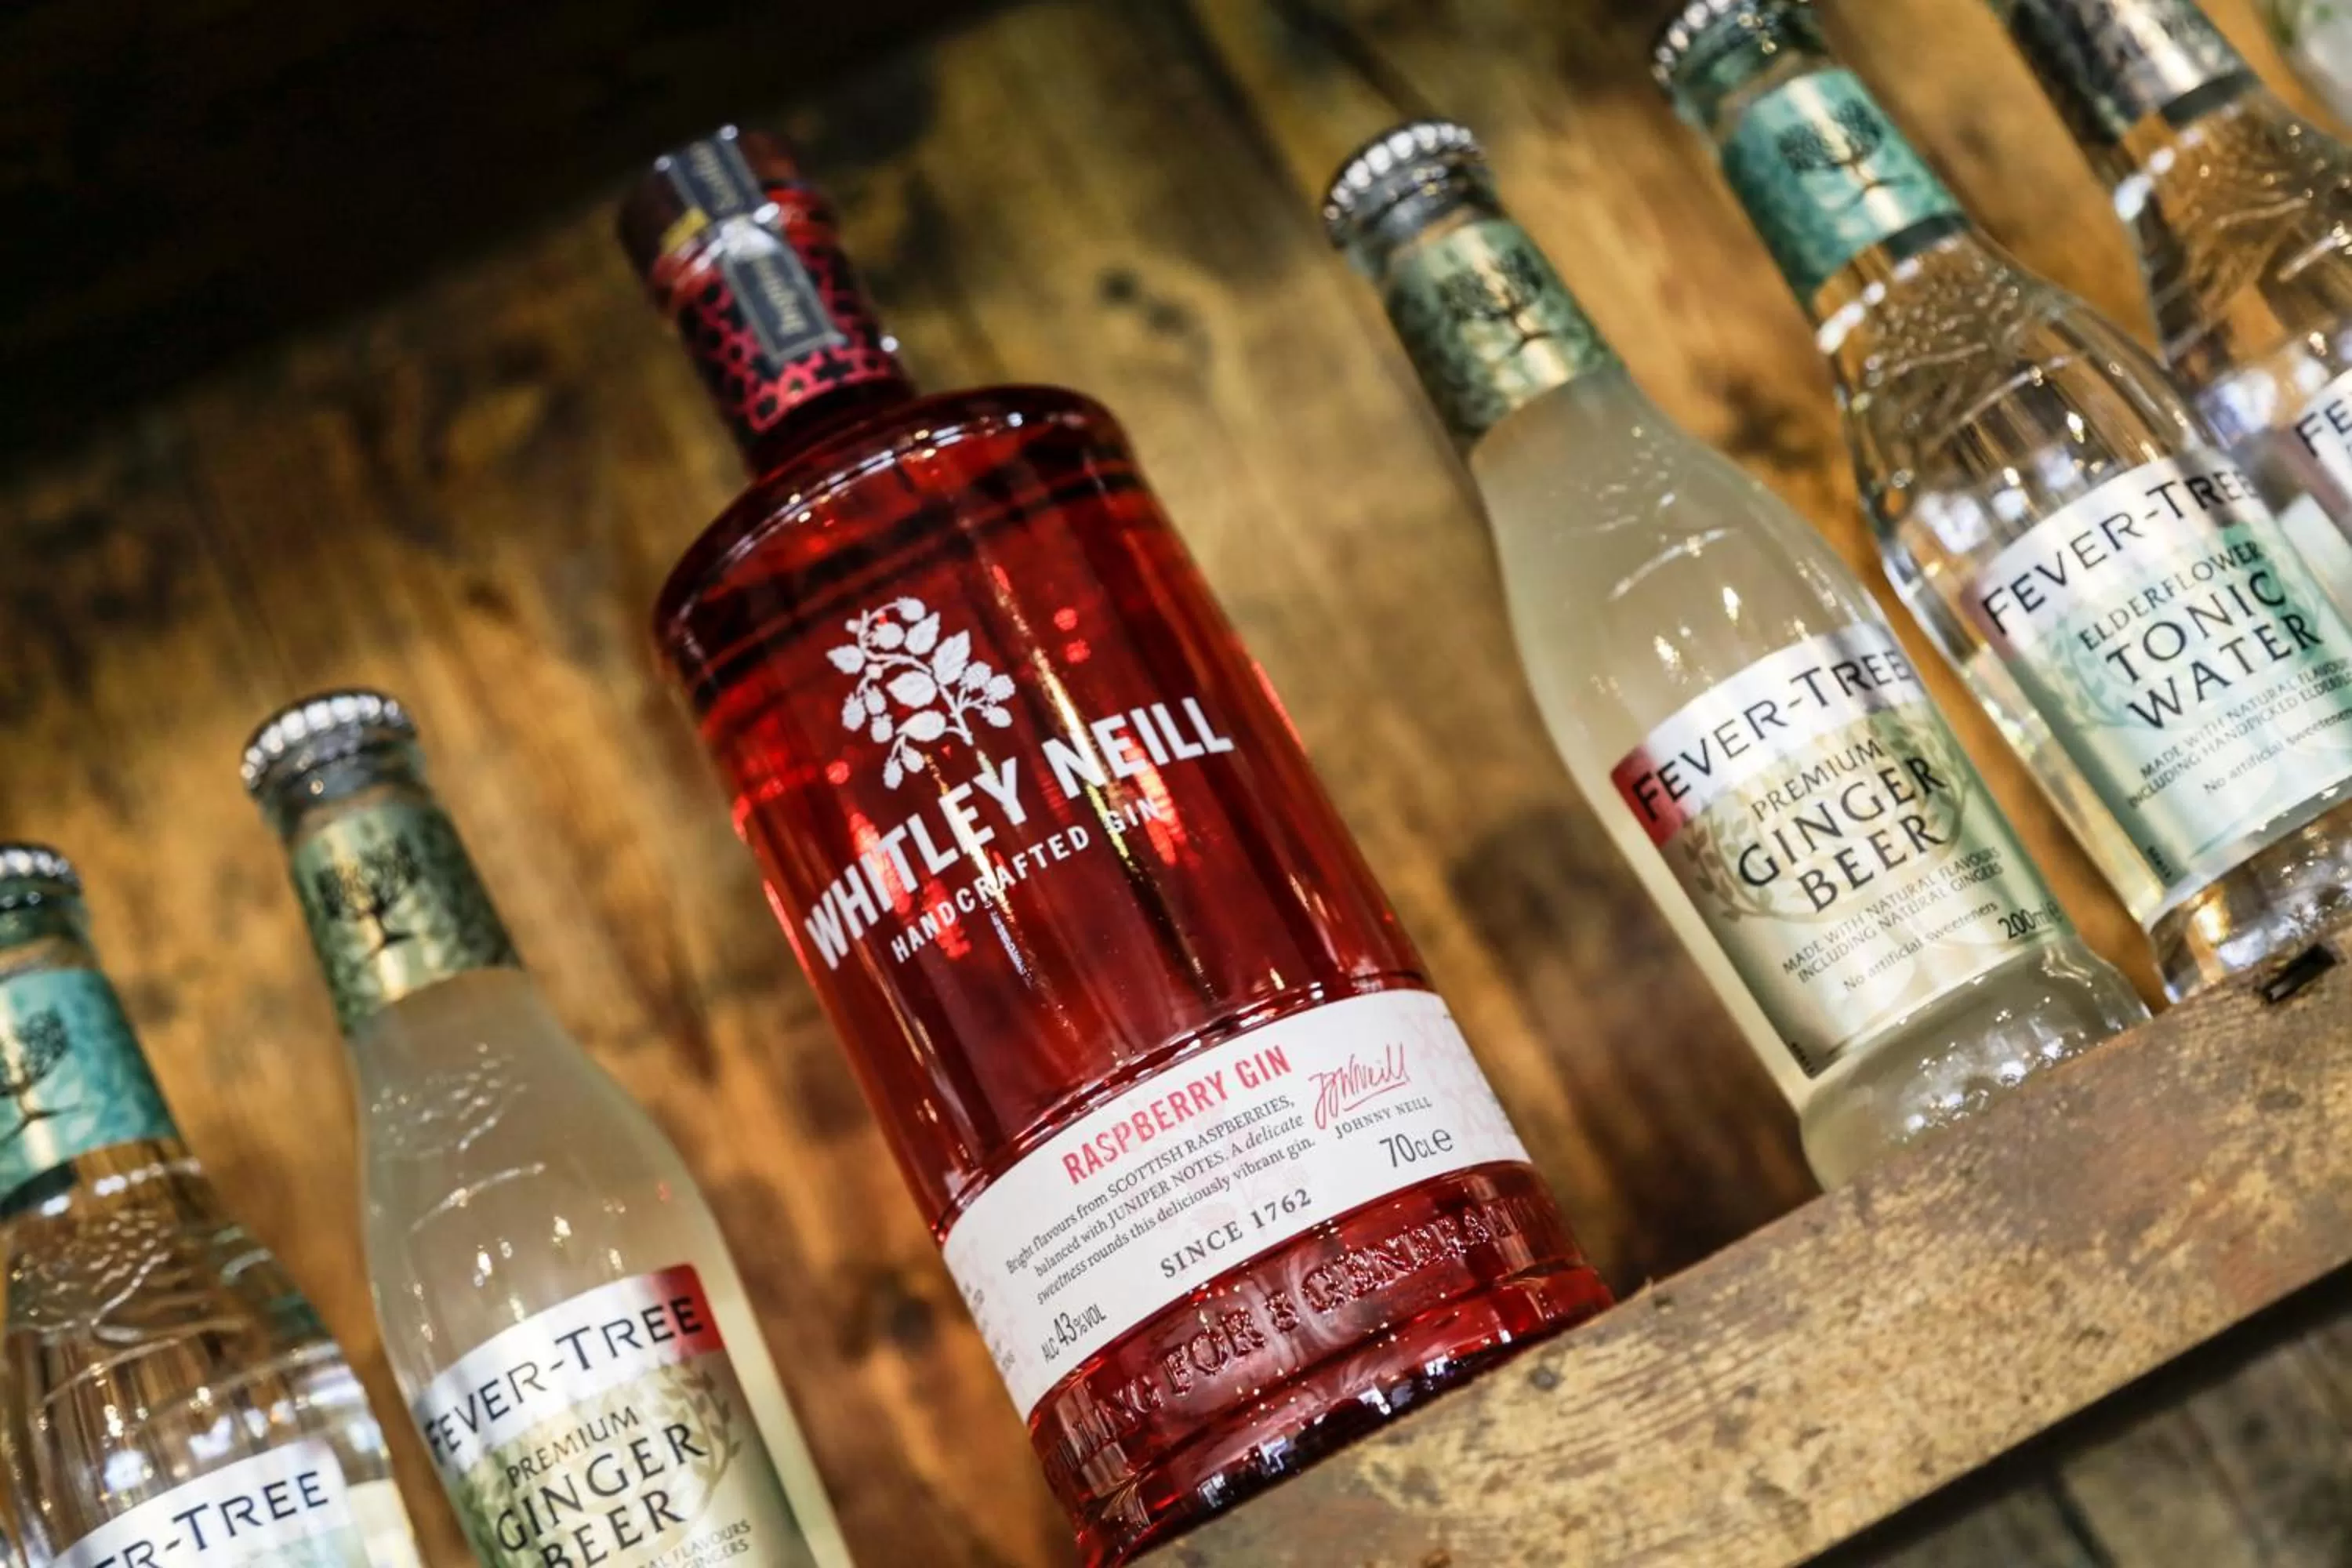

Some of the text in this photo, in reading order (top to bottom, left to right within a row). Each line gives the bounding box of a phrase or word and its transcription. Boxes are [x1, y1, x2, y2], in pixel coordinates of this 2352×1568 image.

[1980, 470, 2261, 636] FEVER-TREE
[2078, 539, 2264, 653] ELDERFLOWER
[2105, 568, 2288, 685] TONIC
[2126, 613, 2324, 732] WATER
[1632, 648, 1915, 823] FEVER-TREE
[2140, 745, 2183, 780] MADE
[2183, 717, 2226, 747] WITH
[2226, 678, 2297, 721] NATURAL
[2203, 696, 2299, 757] HANDPICKED
[2203, 775, 2227, 796] No
[2229, 741, 2285, 779] artificial
[1737, 756, 1946, 890] GINGER
[1751, 738, 1886, 824] PREMIUM
[804, 698, 1234, 971] WHITLEY NEILL
[891, 799, 1163, 964] HANDCRAFTED GIN
[1798, 813, 1945, 914] BEER
[1782, 942, 1826, 975] MADE
[1824, 914, 1866, 944] WITH
[1865, 876, 1936, 922] NATURAL
[1798, 926, 1878, 983] INCLUDING
[1878, 887, 1947, 931] NATURAL
[1843, 901, 1998, 993] No artificial sweeteners
[1062, 1044, 1292, 1185] RASPBERRY GIN
[1334, 1096, 1433, 1140] JOHNNY NEILL
[1005, 1094, 1295, 1274] Bright flavours from SCOTTISH RASPBERRIES,
[1034, 1113, 1305, 1277] balanced with JUNIPER NOTES. A delicate
[1037, 1138, 1316, 1306] sweetness rounds this deliciously vibrant gin.
[1160, 1188, 1312, 1279] SINCE 1762
[423, 1295, 704, 1465] FEVER-TREE
[1040, 1334, 1061, 1363] ALC
[1163, 1305, 1267, 1398] FOR
[496, 1423, 710, 1552] GINGER
[506, 1405, 641, 1490] PREMIUM
[93, 1470, 330, 1568] R-TREE
[540, 1490, 688, 1568] BEER
[672, 1517, 752, 1563] FLAVOURS
